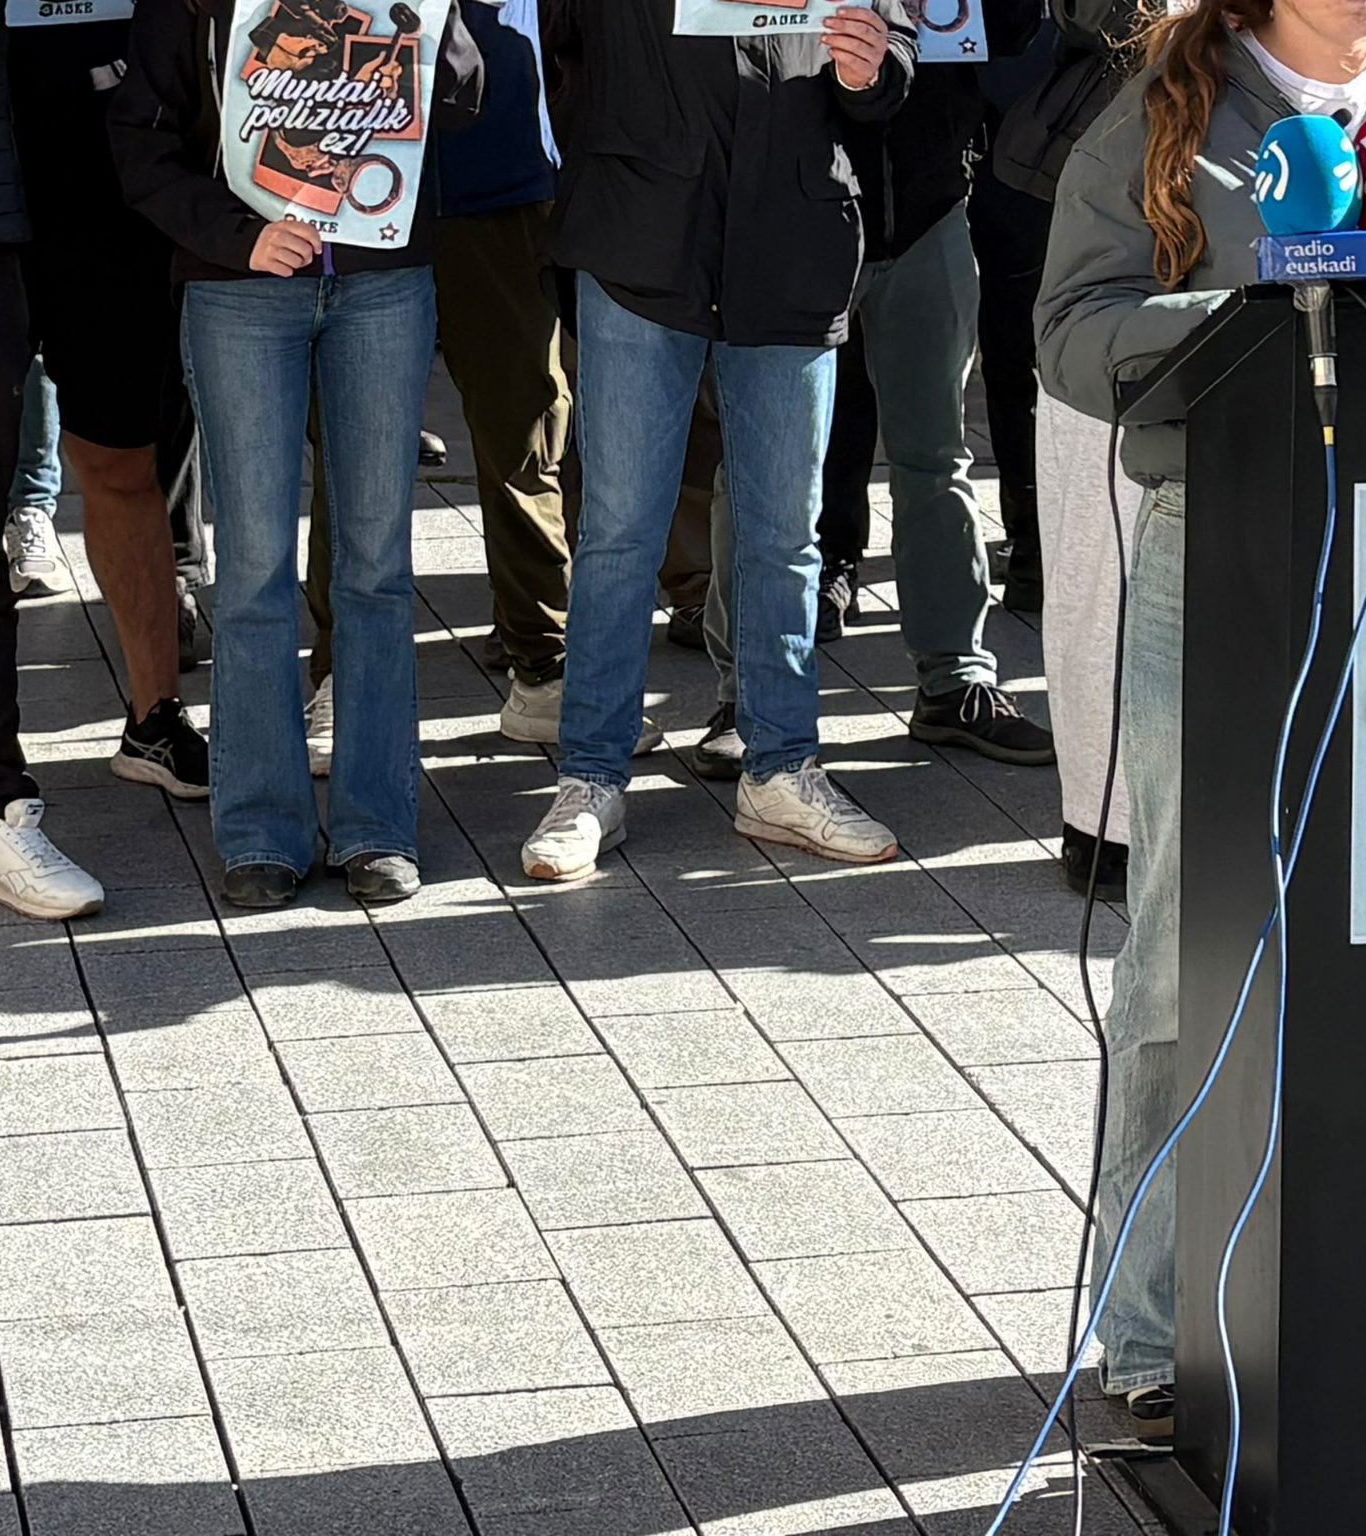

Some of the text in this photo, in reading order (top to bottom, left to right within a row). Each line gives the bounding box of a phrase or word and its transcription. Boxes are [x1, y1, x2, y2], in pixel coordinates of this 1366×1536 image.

[247, 68, 380, 102] Muntai
[240, 98, 412, 141] polizialik
[321, 131, 371, 154] ez!
[1285, 241, 1334, 258] radio
[1285, 256, 1356, 275] euskadi
